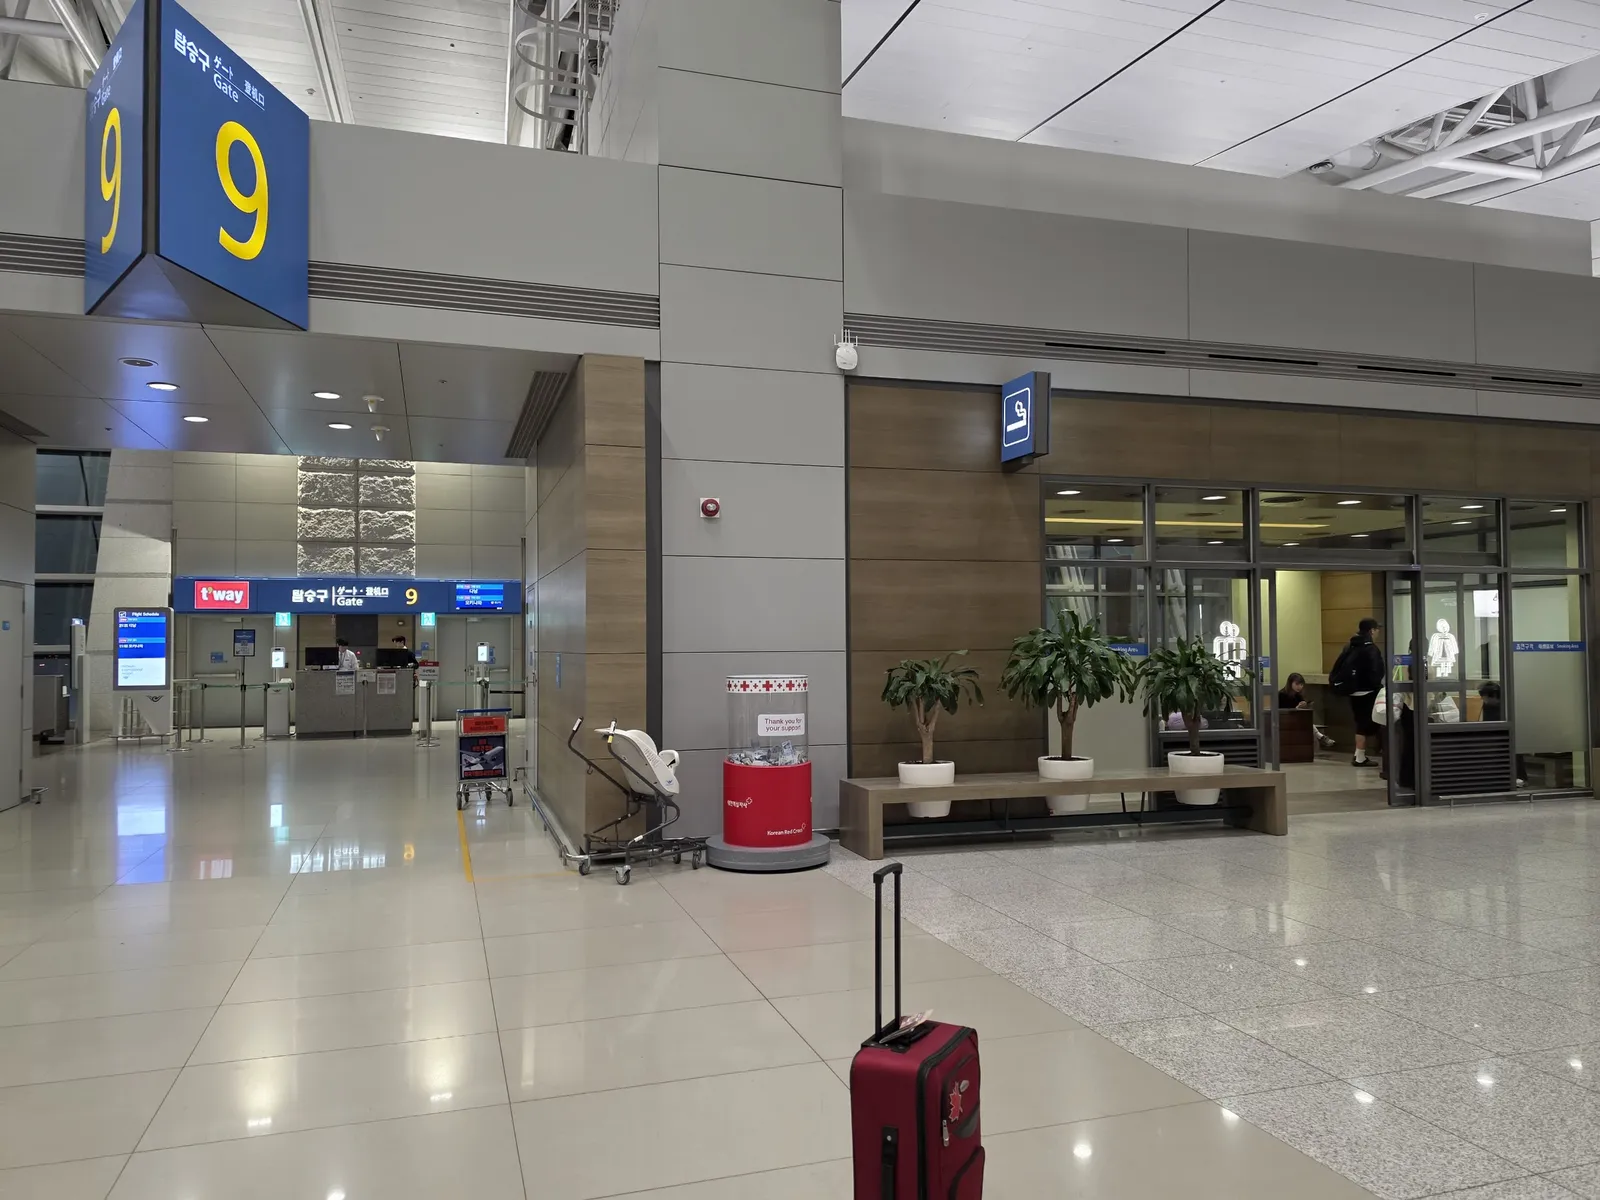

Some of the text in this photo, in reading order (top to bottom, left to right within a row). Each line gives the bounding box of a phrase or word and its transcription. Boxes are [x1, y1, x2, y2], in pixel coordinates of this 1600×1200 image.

[174, 28, 210, 72] 탑승구
[213, 55, 233, 80] ゲート
[213, 73, 239, 103] Gate
[101, 107, 122, 254] 9
[215, 120, 269, 260] 9
[292, 589, 329, 603] 탑승구
[336, 597, 364, 607] Gate
[405, 588, 418, 605] 9
